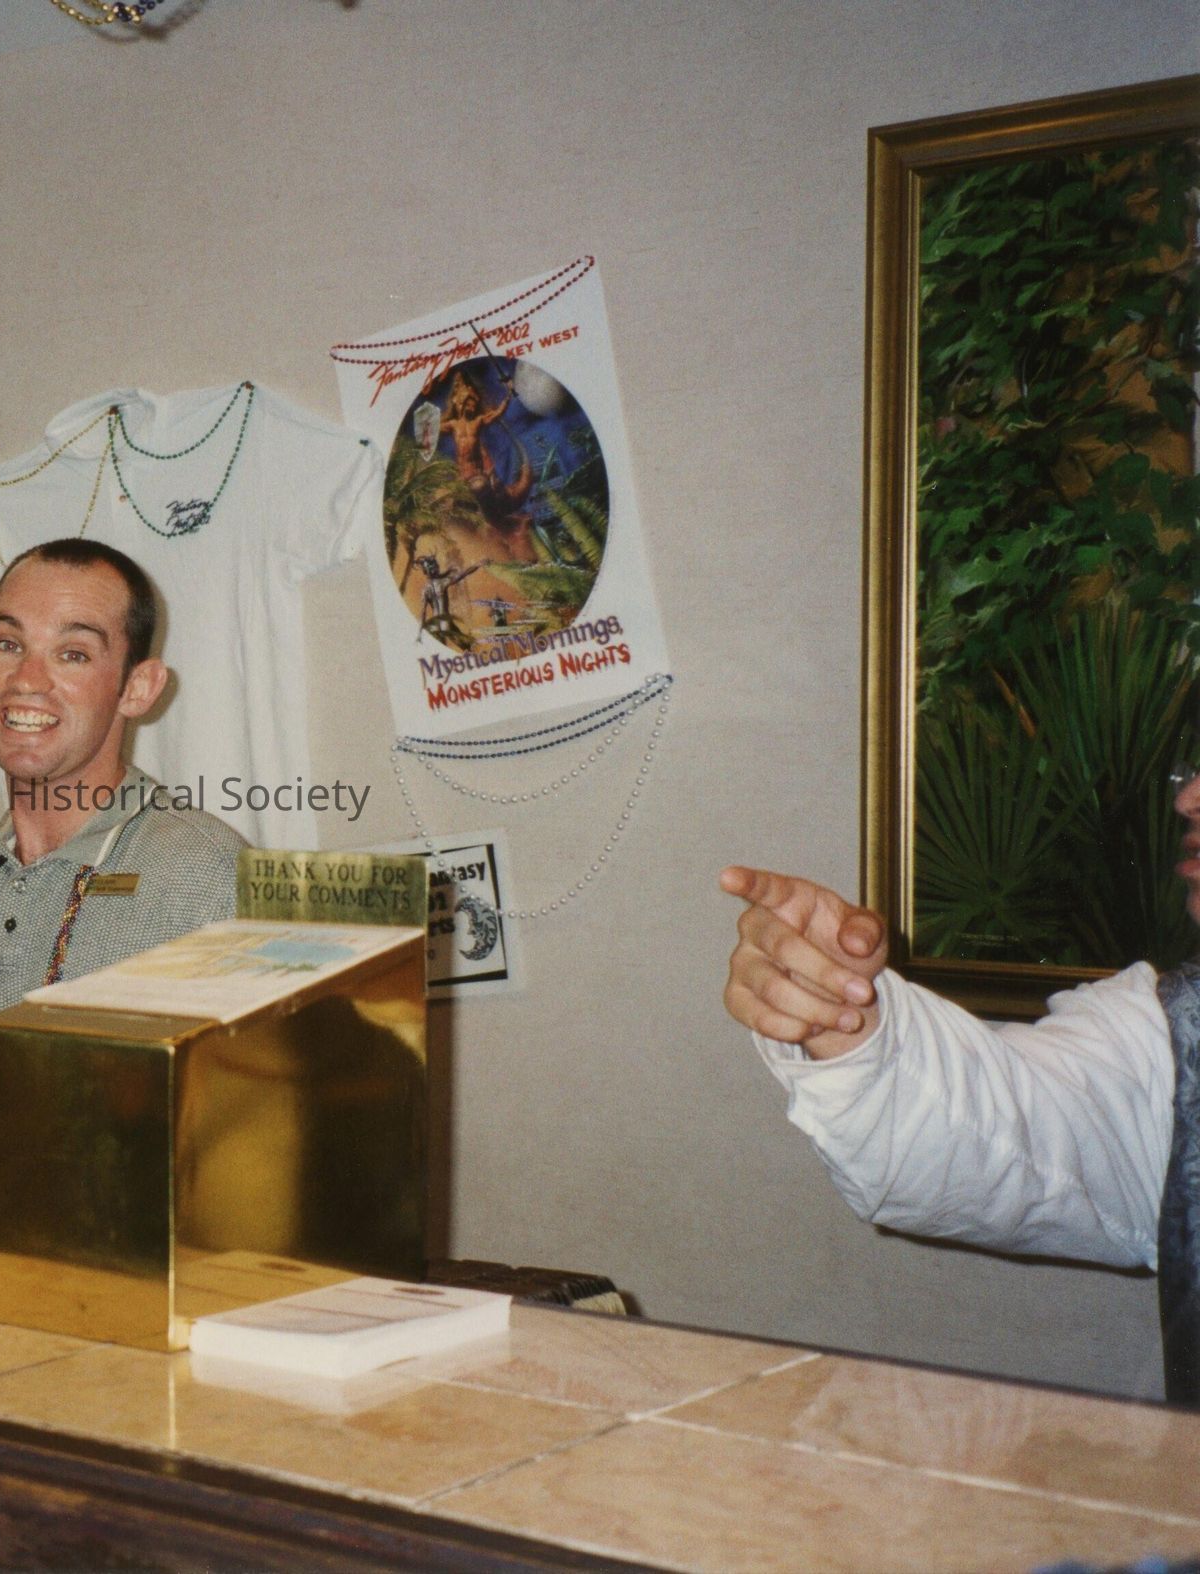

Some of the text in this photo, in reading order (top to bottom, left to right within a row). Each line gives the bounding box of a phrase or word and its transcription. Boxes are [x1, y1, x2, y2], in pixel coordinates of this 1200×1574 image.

[505, 326, 580, 361] KEY WEST
[368, 353, 444, 408] Fantasy
[496, 322, 530, 347] 2002
[418, 636, 509, 686] Mystical
[255, 859, 411, 885] THANK YOU FOR
[250, 882, 300, 902] YOUR
[307, 884, 411, 911] COMMENTS
